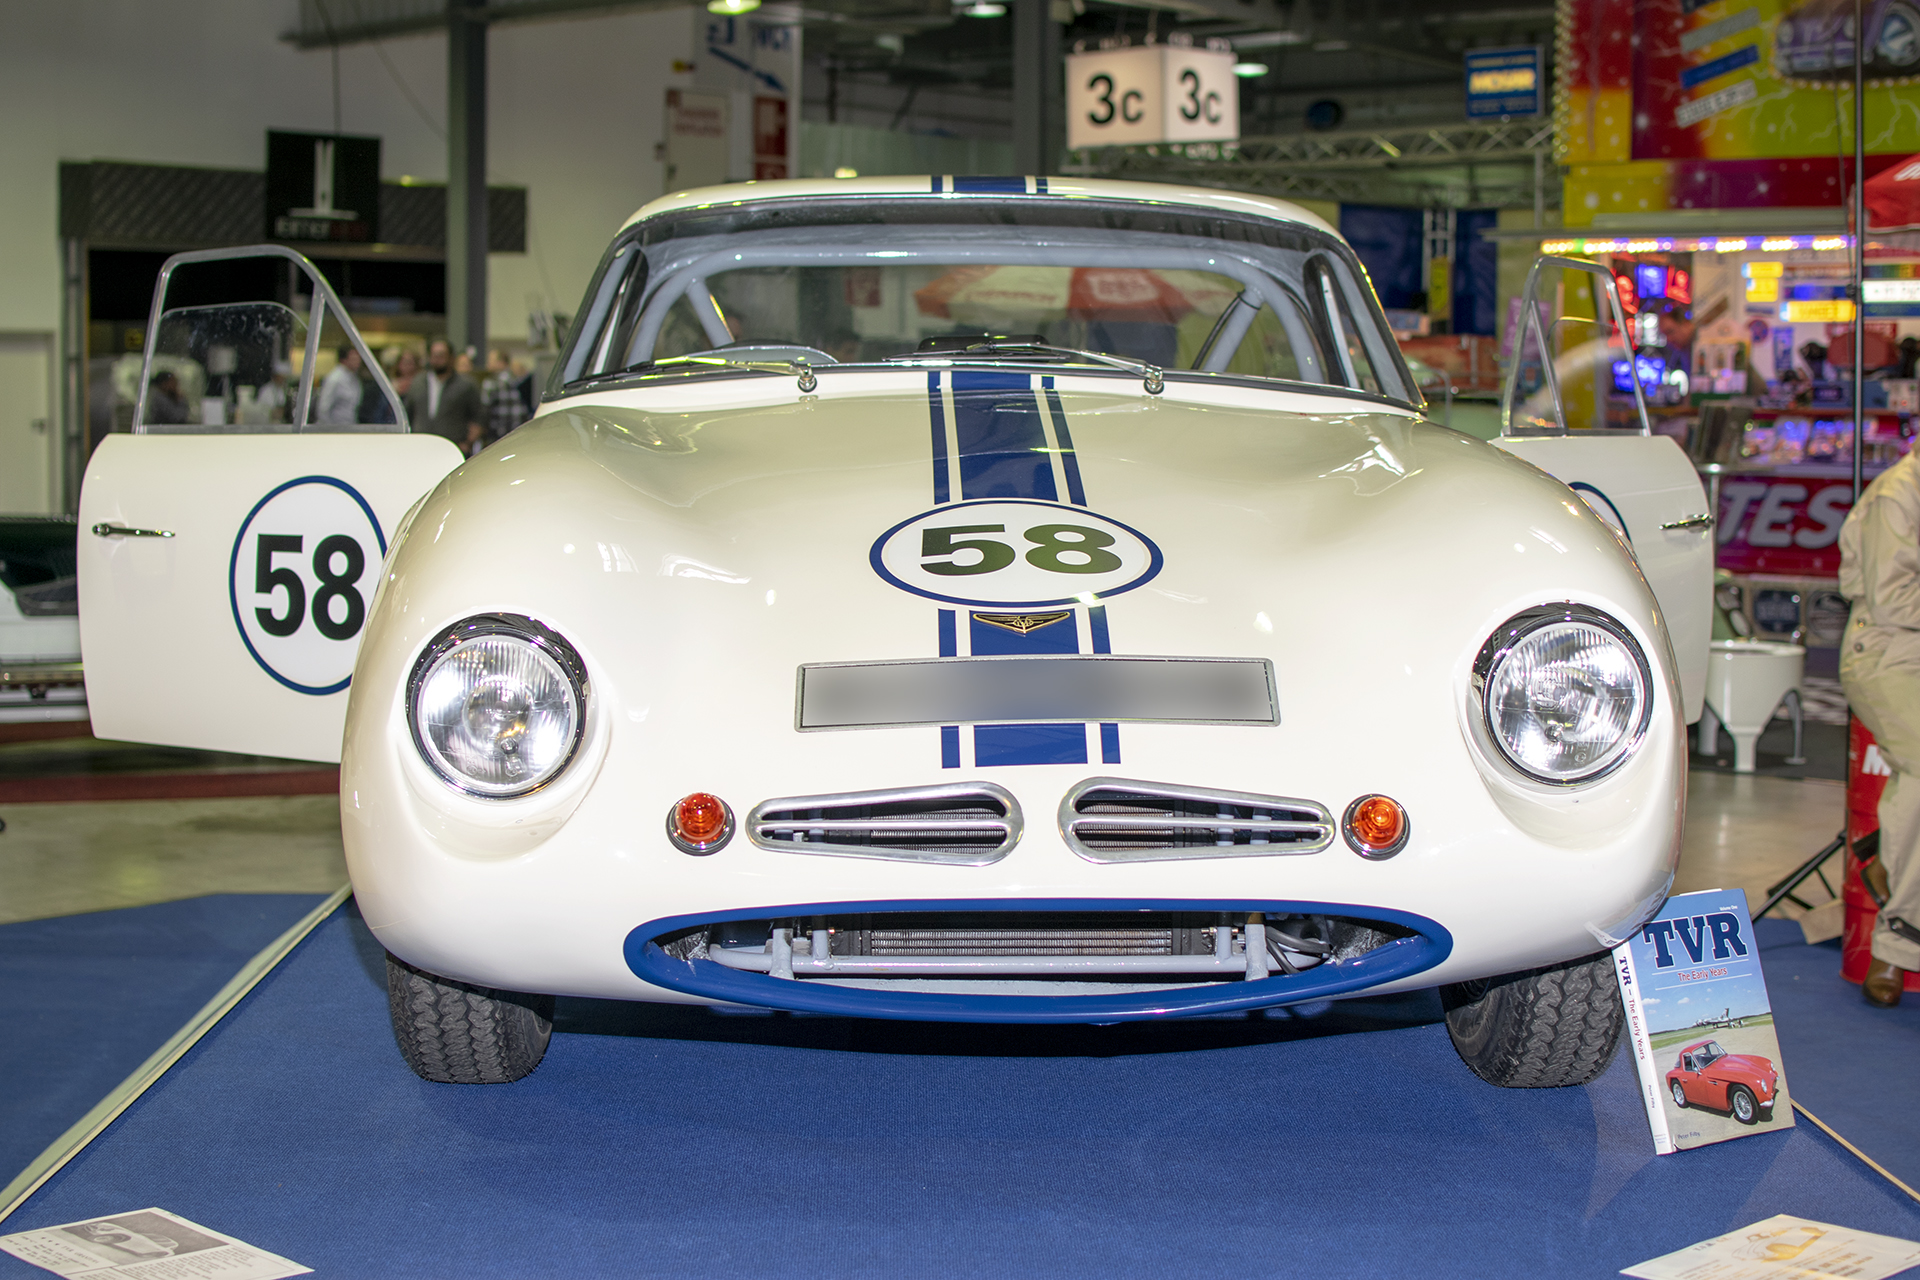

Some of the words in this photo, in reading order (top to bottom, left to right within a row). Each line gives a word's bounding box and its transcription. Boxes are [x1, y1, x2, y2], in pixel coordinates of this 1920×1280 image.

[920, 524, 1122, 576] 58
[255, 533, 366, 641] 58
[1642, 911, 1748, 969] TVR
[1678, 972, 1691, 982] The
[1692, 969, 1709, 980] Early
[1709, 967, 1728, 977] Years
[1619, 956, 1632, 986] TVR
[1632, 1016, 1641, 1037] Early
[1637, 1038, 1645, 1060] Years
